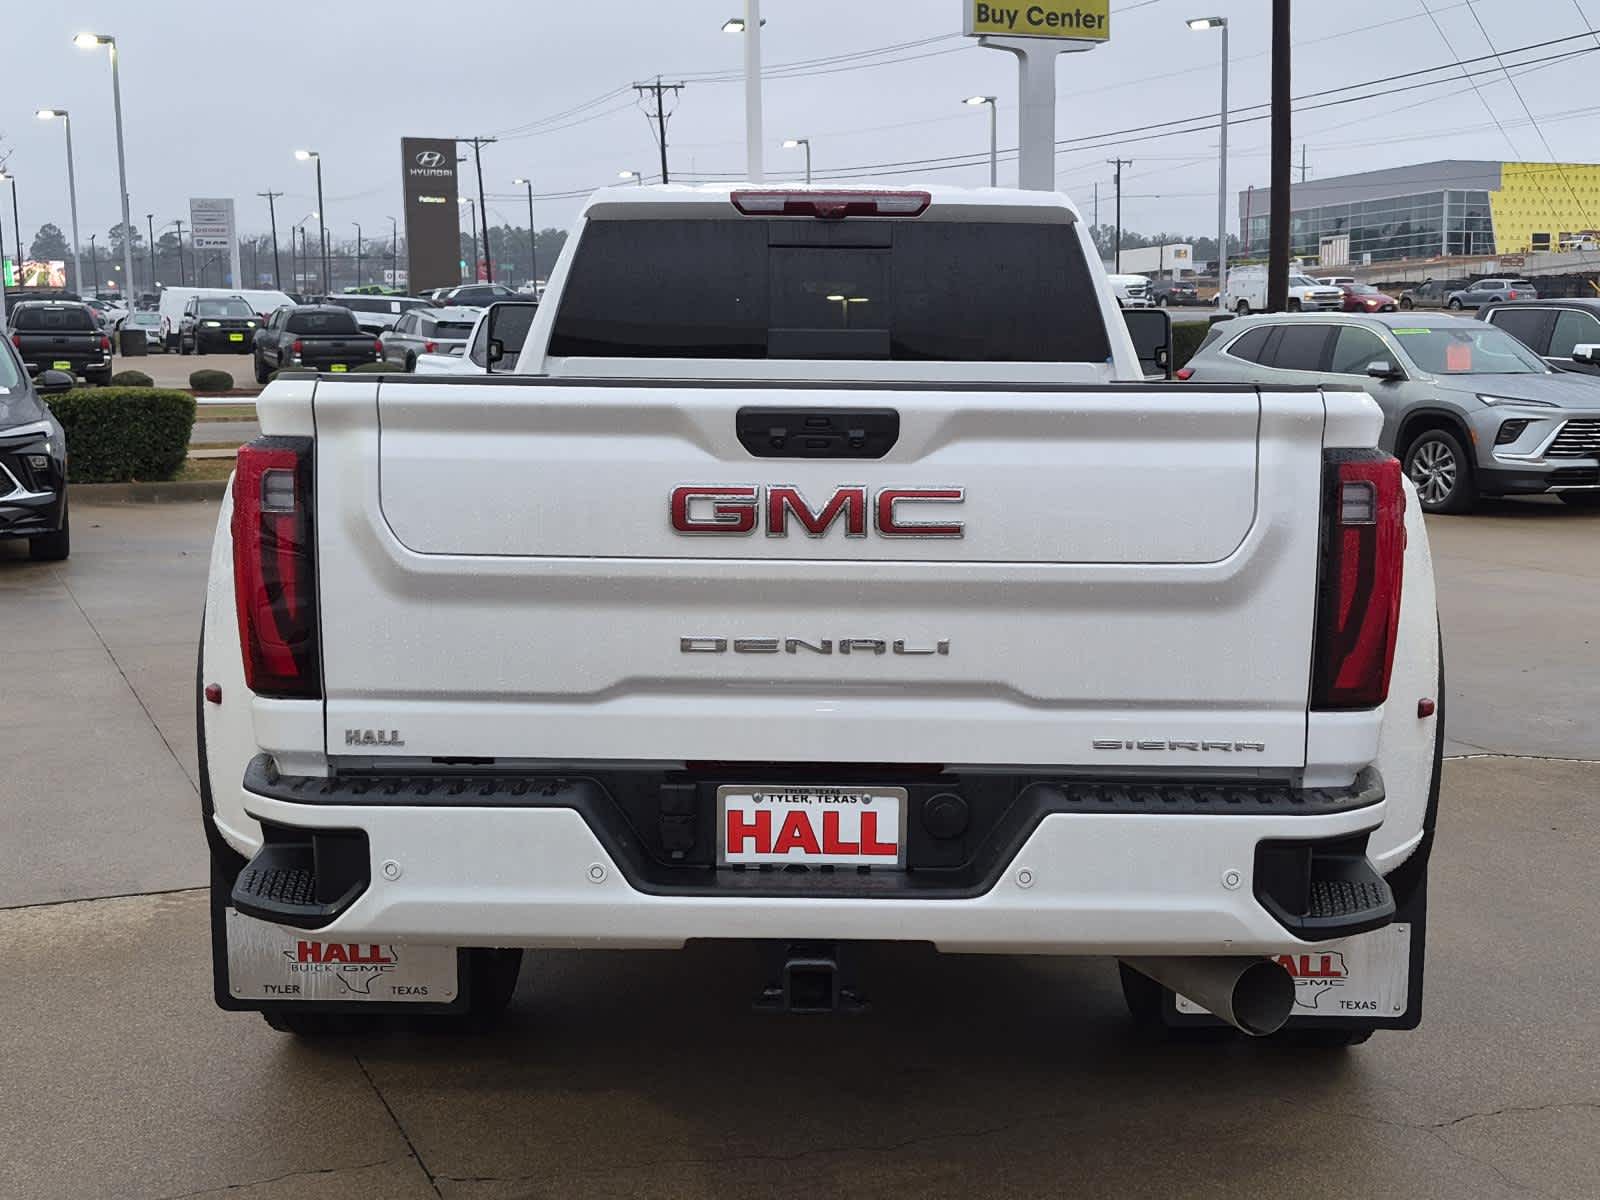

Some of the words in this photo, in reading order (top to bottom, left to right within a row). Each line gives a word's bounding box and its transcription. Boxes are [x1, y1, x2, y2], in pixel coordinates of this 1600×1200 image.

[976, 3, 1018, 29] Buy
[1026, 5, 1105, 29] Center
[410, 168, 453, 177] HYUNDAI
[670, 484, 966, 539] GMC
[680, 636, 950, 655] DENALI
[345, 729, 405, 745] HALL
[1092, 739, 1265, 752] SIERRA
[768, 794, 812, 804] TYLER,
[816, 794, 858, 804] TEXAS
[727, 809, 898, 856] HALL
[297, 941, 392, 963] HALL
[291, 964, 332, 972] BUICK
[263, 984, 300, 994] TYLER
[391, 986, 429, 995] TEXAS
[1339, 1000, 1377, 1010] TEXAS
